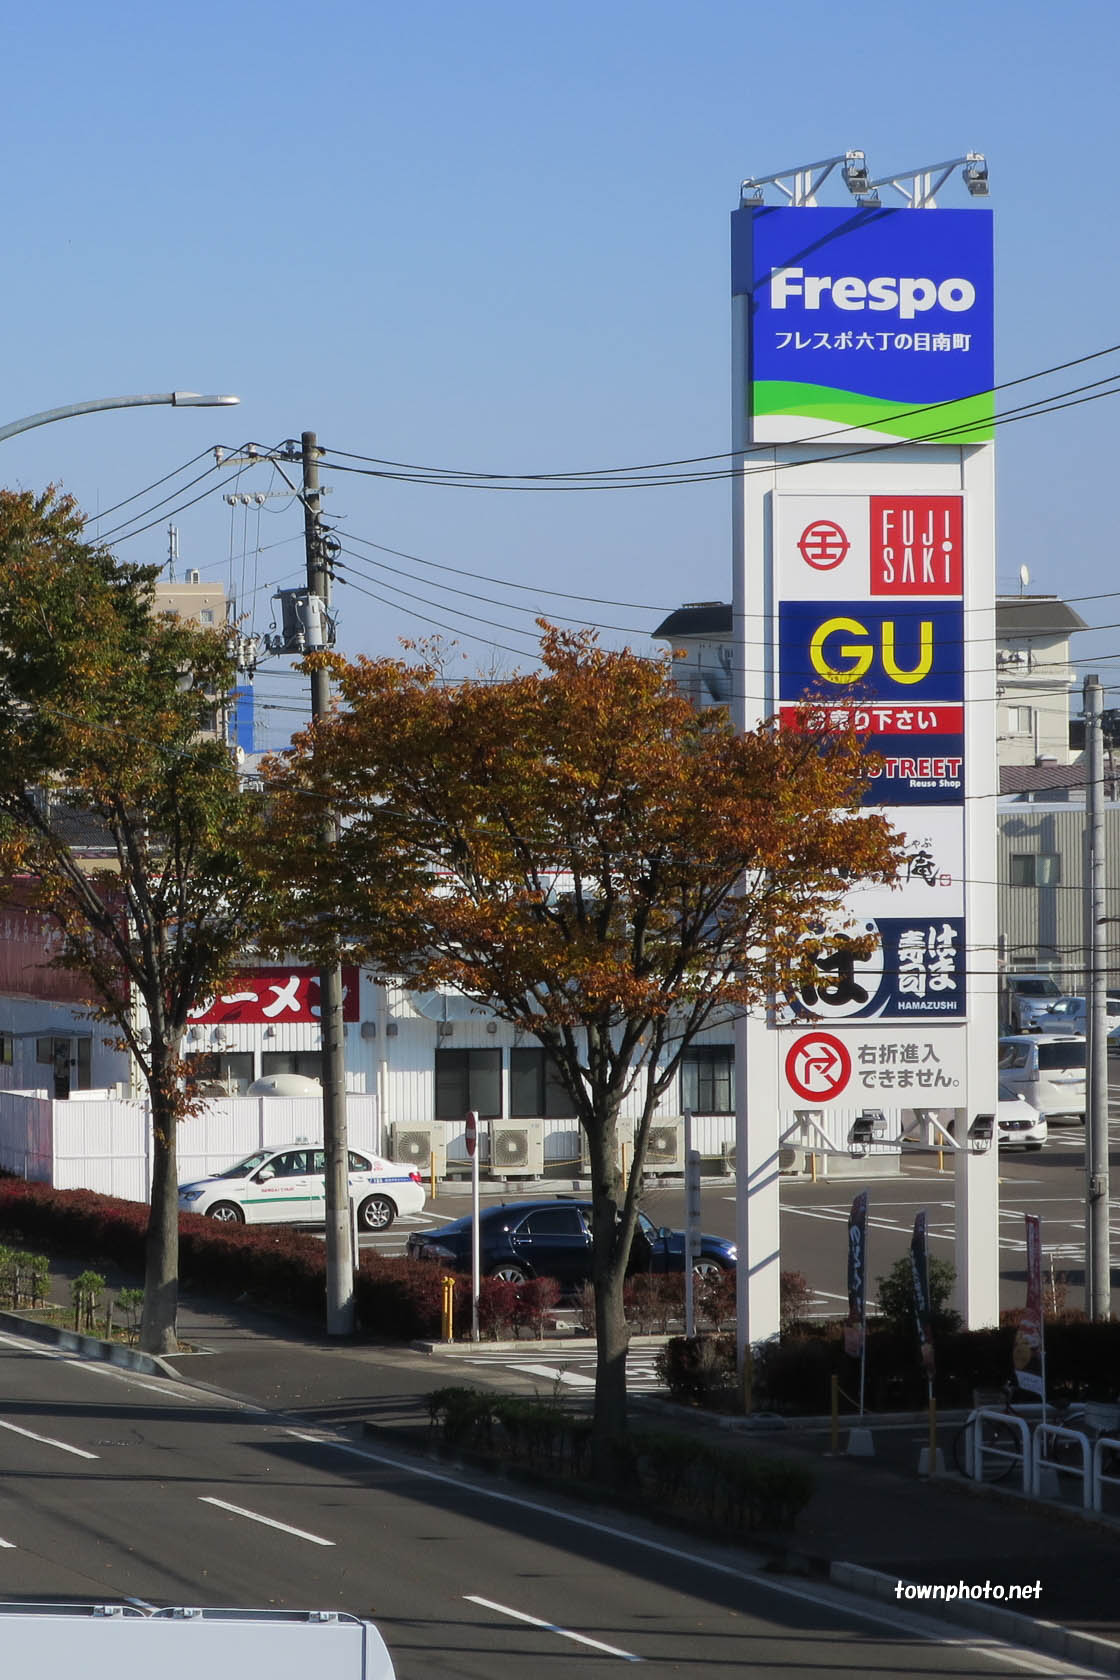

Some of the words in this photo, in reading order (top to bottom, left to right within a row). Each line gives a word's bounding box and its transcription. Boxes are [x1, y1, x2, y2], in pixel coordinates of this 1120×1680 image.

[770, 267, 976, 319] Frespo
[775, 331, 972, 353] フレスポ六丁の目南町
[809, 617, 935, 684] GU
[909, 779, 937, 788] Reuse
[939, 779, 961, 789] Shop
[857, 1043, 941, 1065] 右折進入
[858, 1069, 960, 1089] できません。
